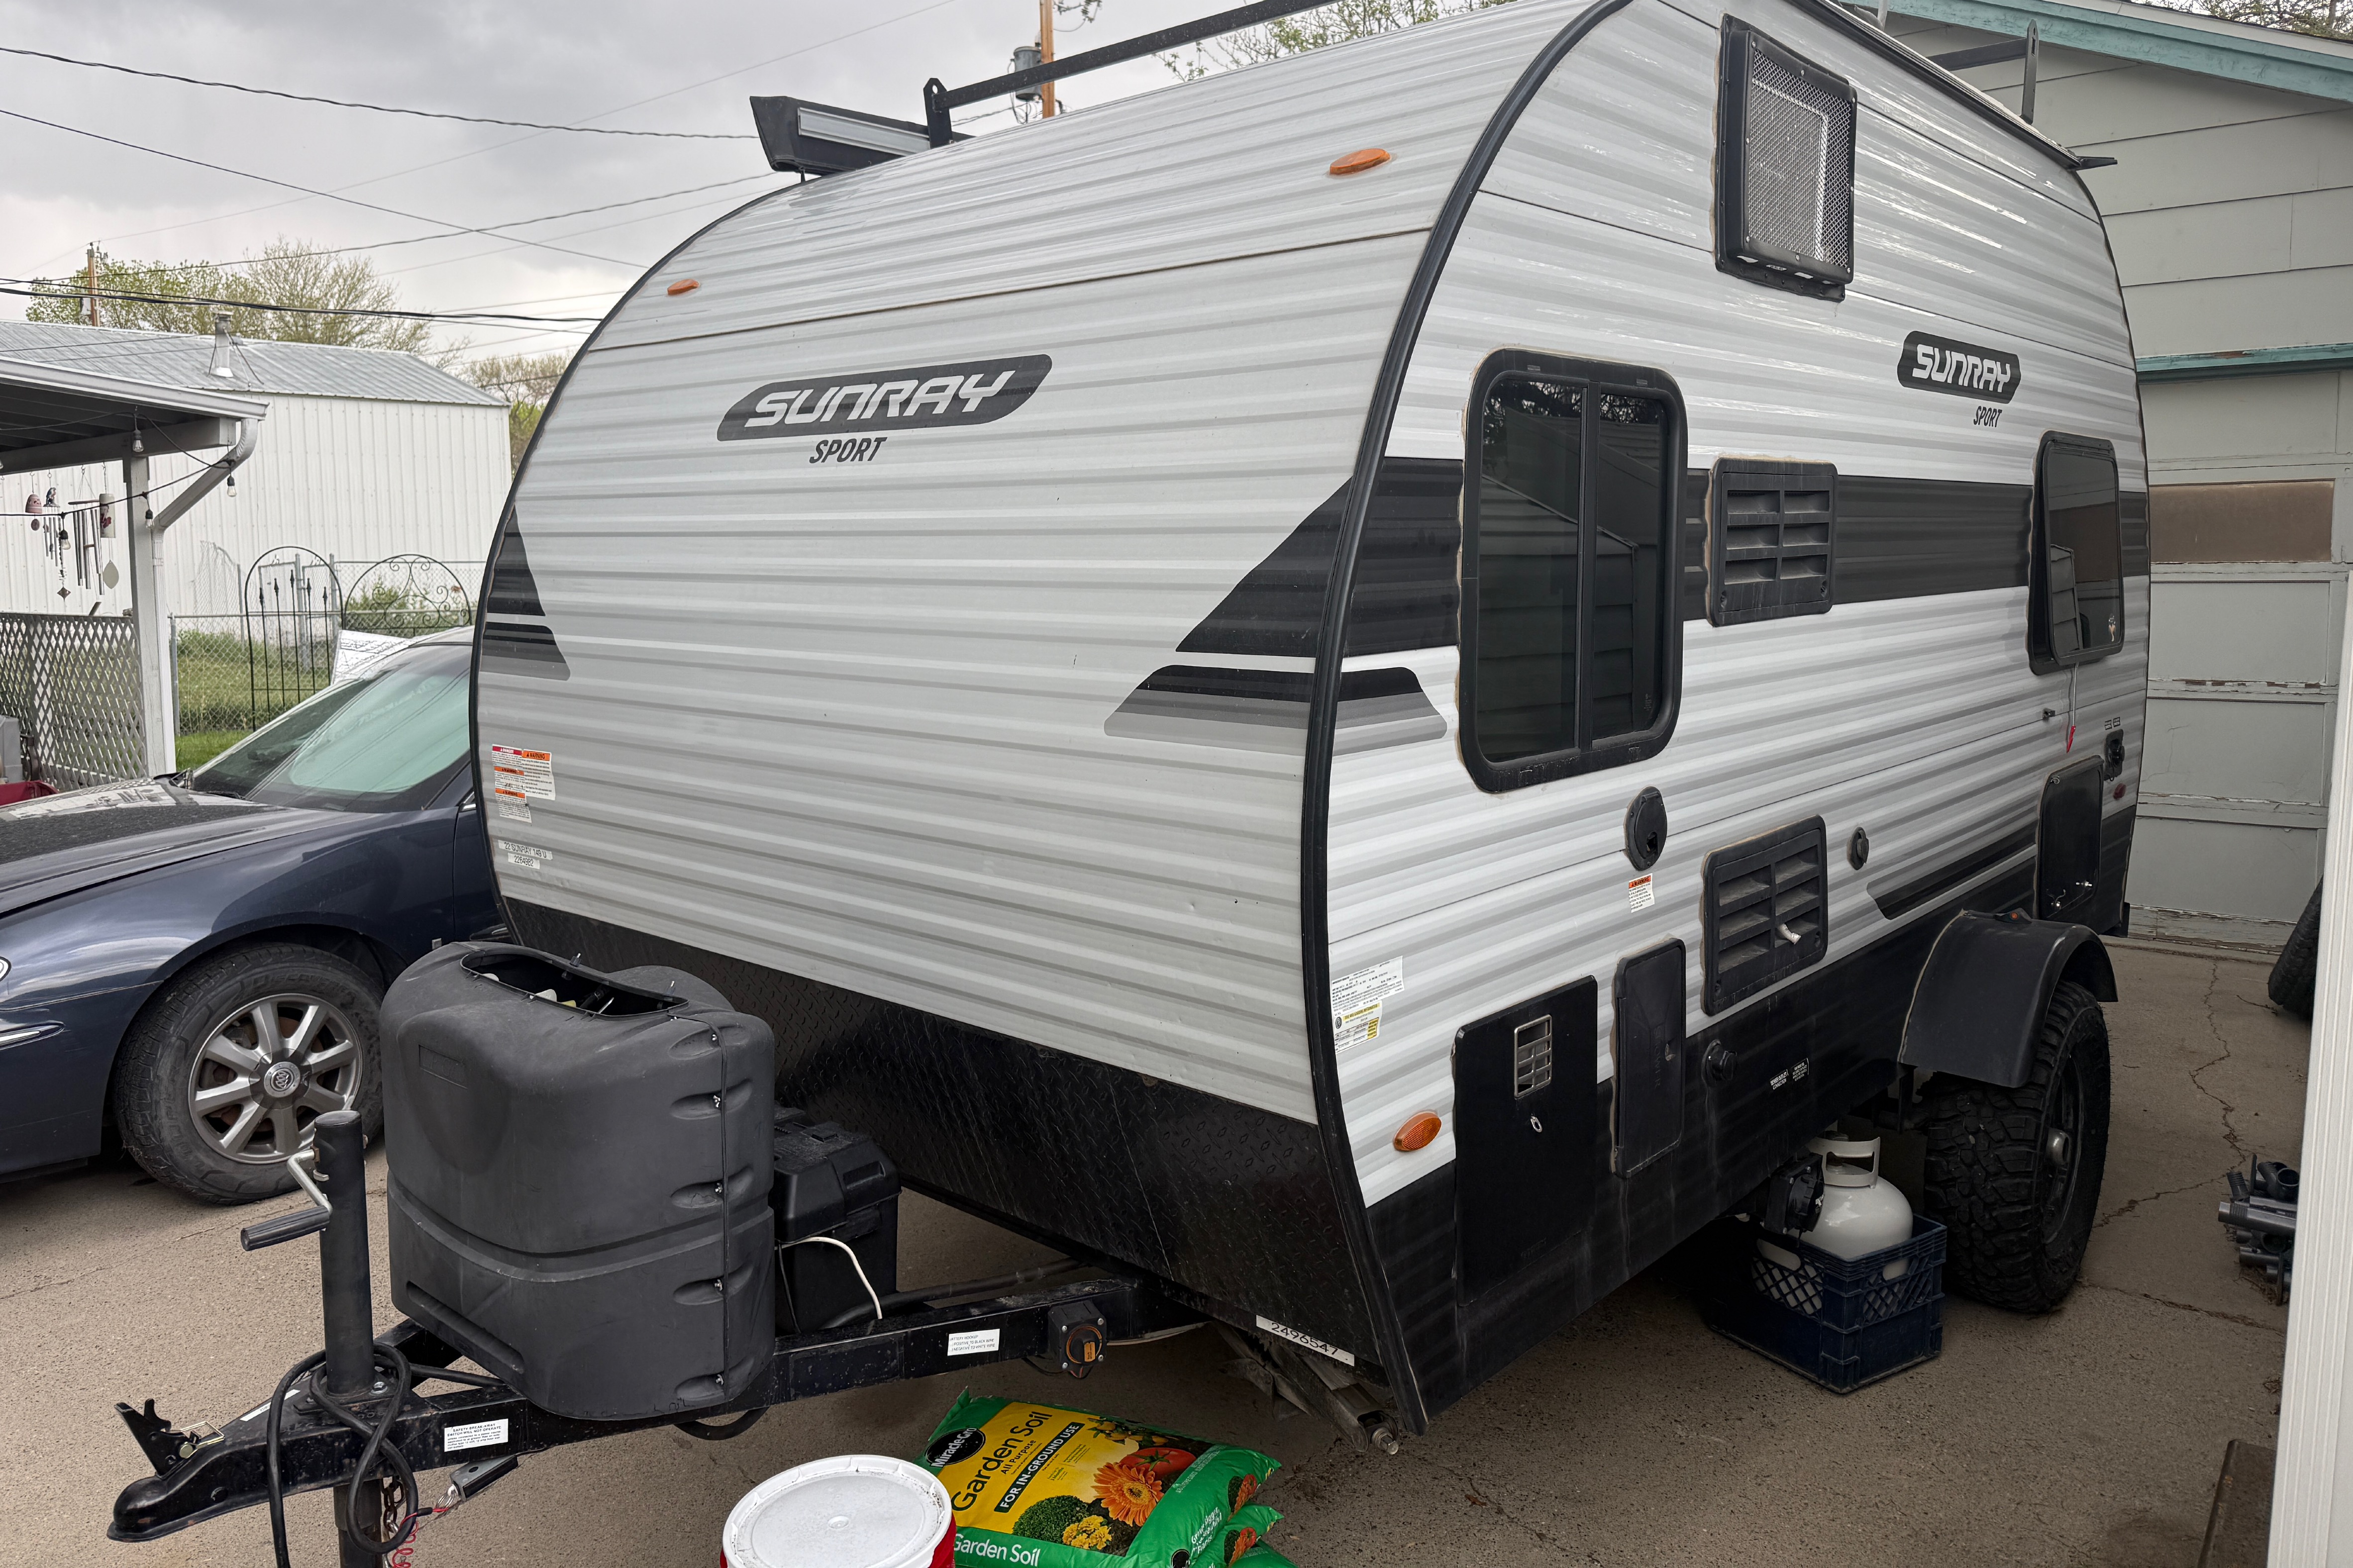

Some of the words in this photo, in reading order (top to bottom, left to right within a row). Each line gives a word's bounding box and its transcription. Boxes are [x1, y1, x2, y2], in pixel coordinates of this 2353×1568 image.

[1912, 344, 2011, 392] SUNRAY
[744, 370, 1016, 427] SUNRAY
[1973, 405, 2002, 427] SPORT
[809, 437, 887, 463] SPORT
[511, 844, 531, 855] SUNRAY
[514, 855, 533, 867] 2264982
[1271, 1322, 1338, 1355] 2496547
[951, 1437, 1018, 1511] Garden
[1010, 1411, 1053, 1437] Soil
[1000, 1463, 1013, 1475] All
[1010, 1440, 1036, 1464] Purpose
[1000, 1486, 1022, 1508] FOR
[1016, 1439, 1064, 1486] IN-GROUND
[1062, 1424, 1080, 1438] USE
[953, 1533, 1007, 1560] Garden
[1010, 1544, 1041, 1567] Soil
